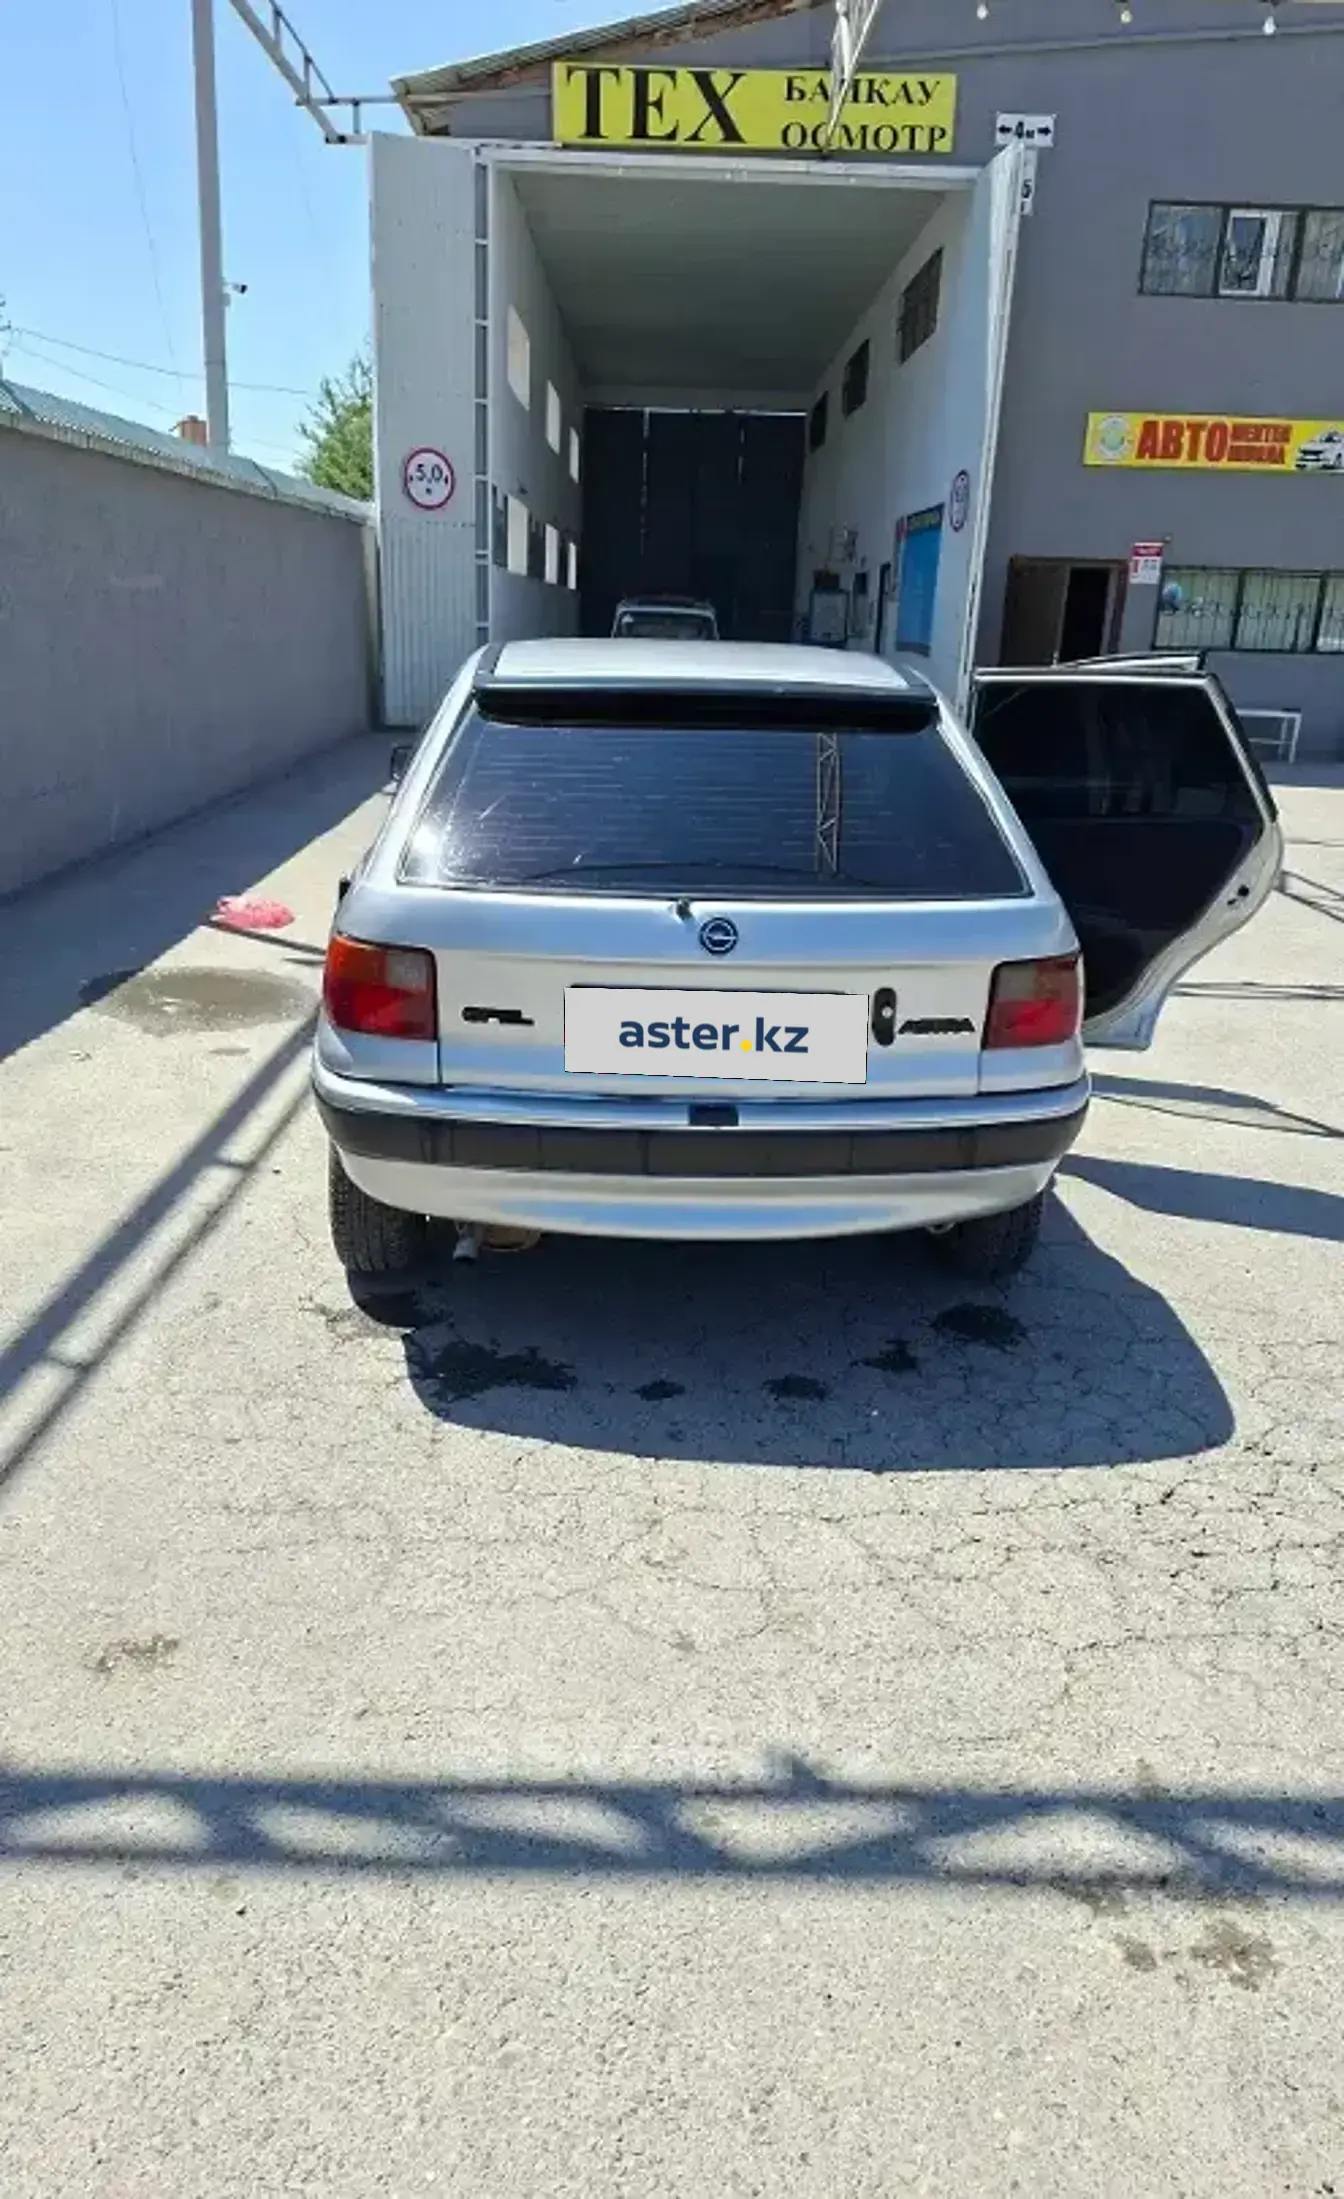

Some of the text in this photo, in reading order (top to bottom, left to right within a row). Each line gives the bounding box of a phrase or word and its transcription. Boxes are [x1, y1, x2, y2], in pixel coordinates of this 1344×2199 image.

[566, 65, 748, 144] ТЕХ
[781, 121, 947, 152] ОСМОТР
[1136, 420, 1229, 462] АВТО
